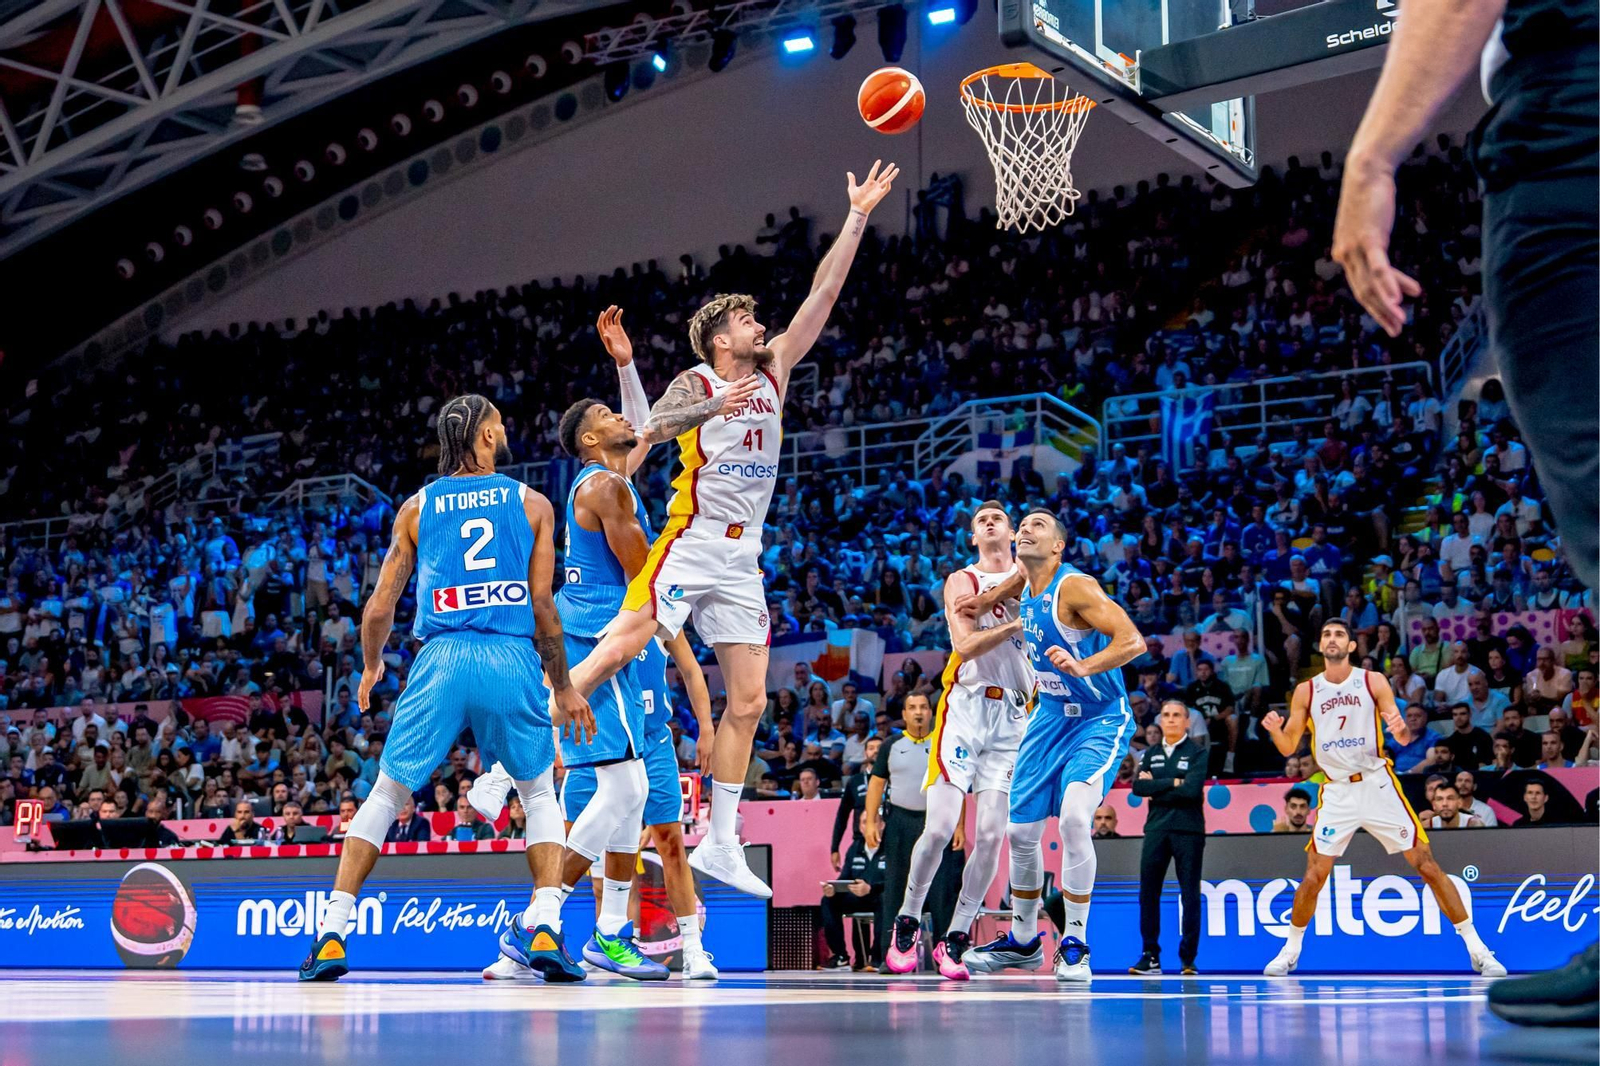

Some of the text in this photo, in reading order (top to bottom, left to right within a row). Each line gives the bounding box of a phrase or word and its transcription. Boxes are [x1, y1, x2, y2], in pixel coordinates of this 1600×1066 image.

[743, 429, 763, 451] 41
[435, 487, 509, 514] NTORSEY
[460, 517, 496, 572] 2
[464, 582, 527, 606] EKO
[1320, 693, 1362, 715] ESPAÑA
[1338, 715, 1347, 731] 7
[1321, 737, 1366, 752] endesa
[392, 897, 442, 934] feel
[438, 902, 477, 931] the
[1497, 873, 1595, 934] feel
